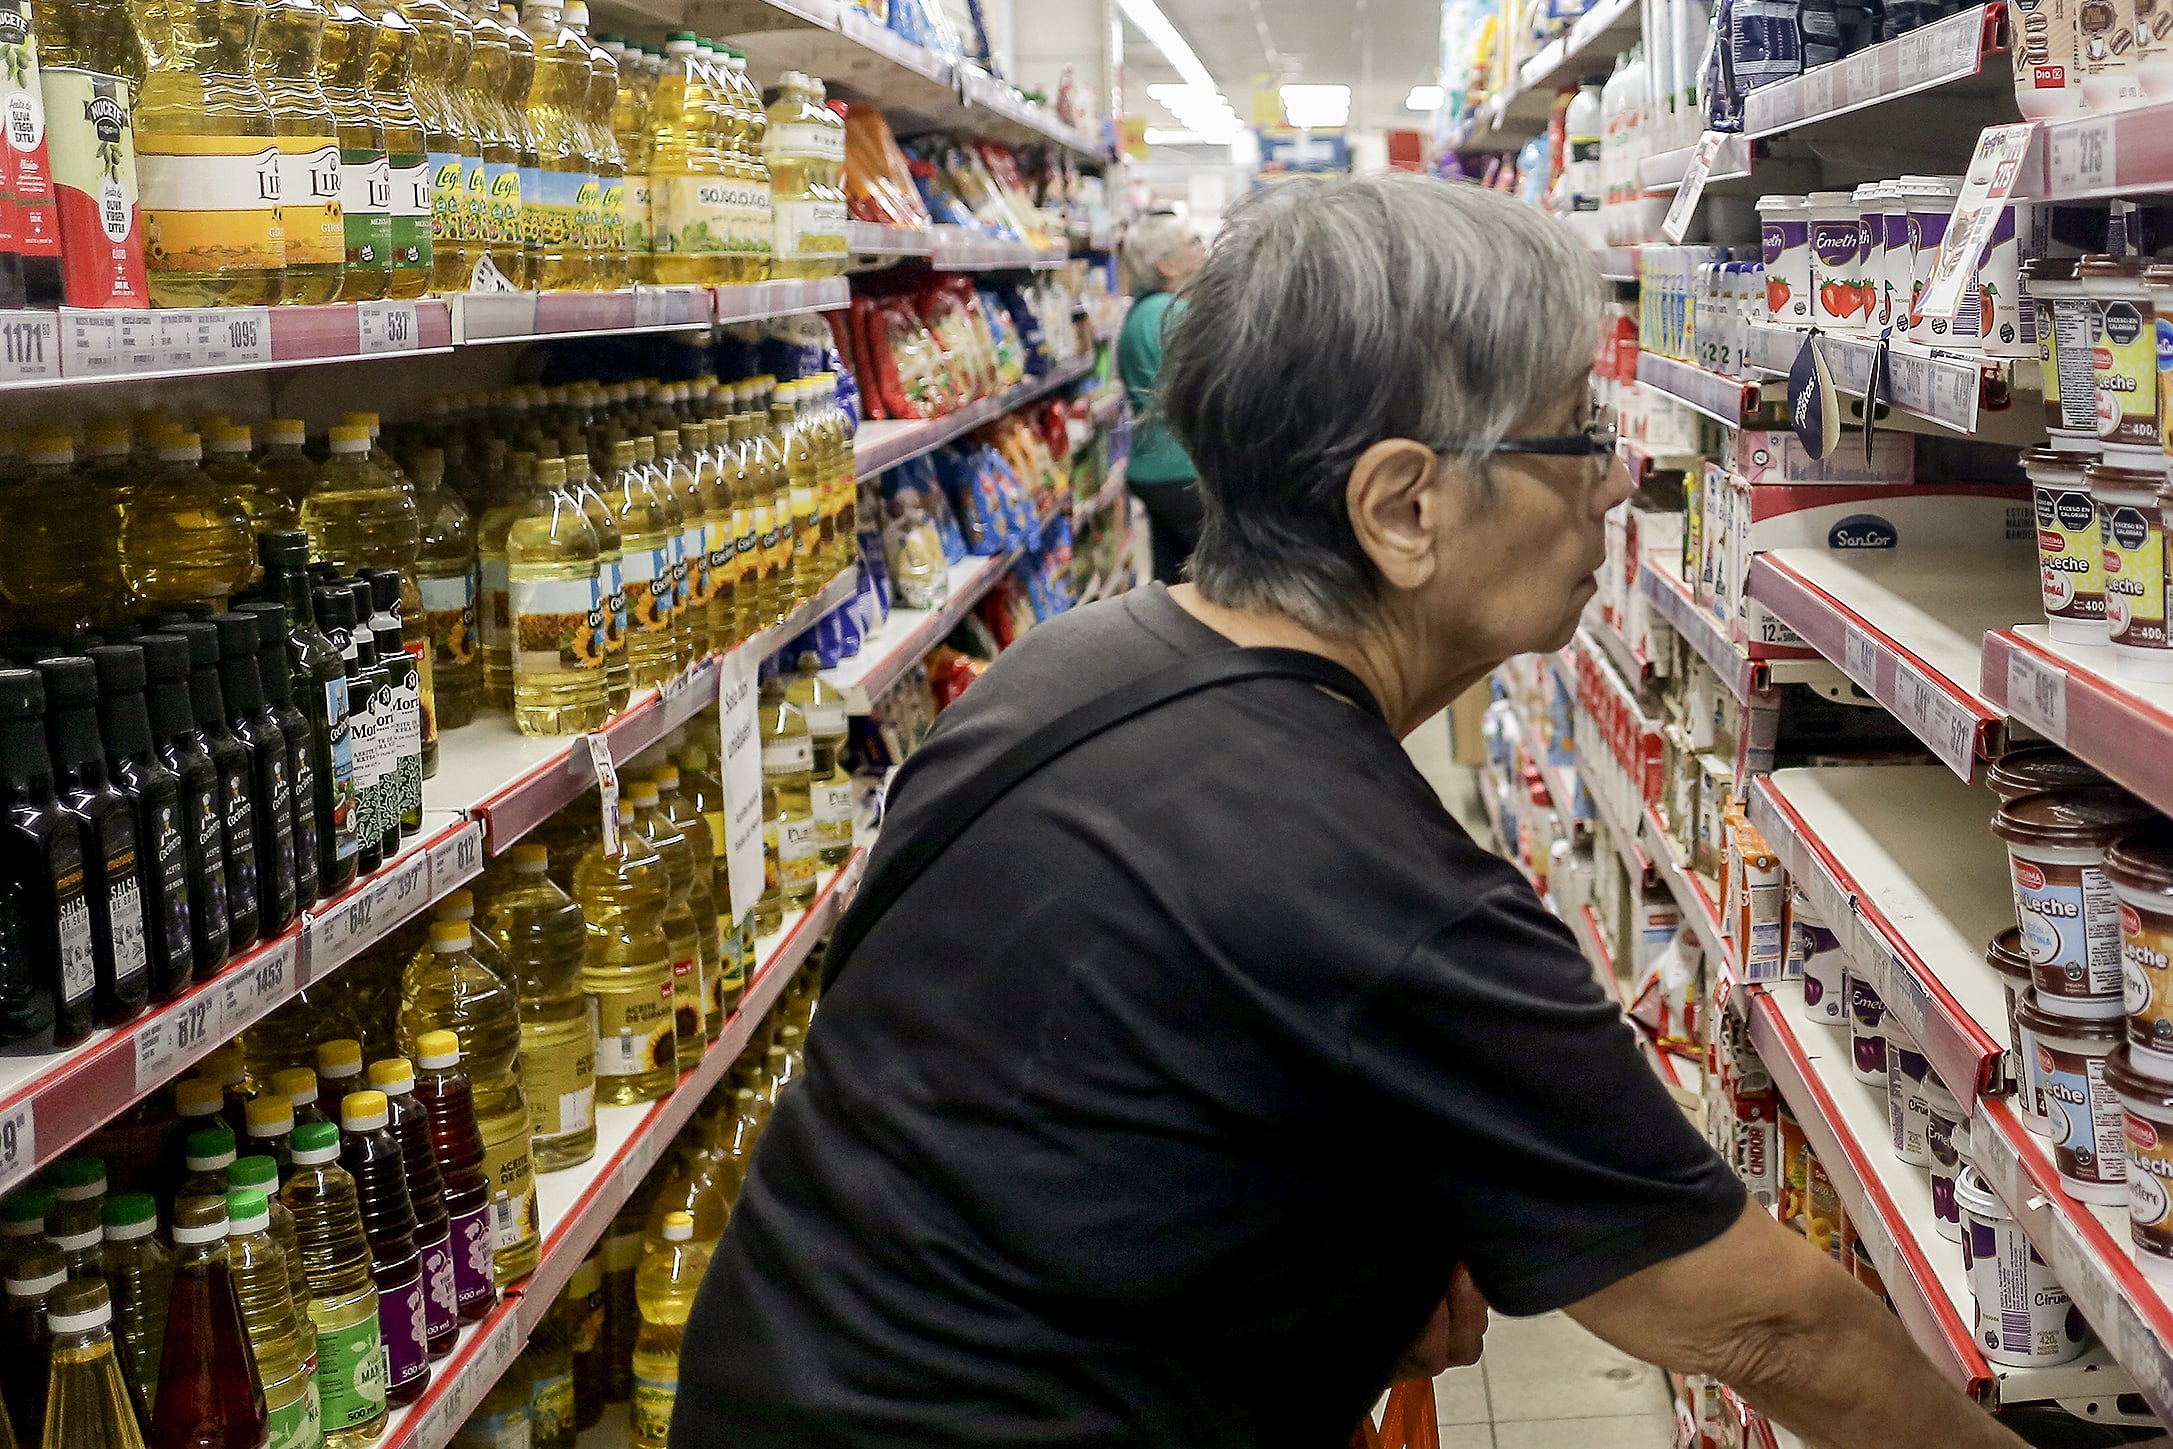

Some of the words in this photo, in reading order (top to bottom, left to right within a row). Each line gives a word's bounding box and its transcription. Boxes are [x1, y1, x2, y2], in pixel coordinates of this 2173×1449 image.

[90, 100, 125, 126] NUCETE
[1817, 231, 1858, 249] Emeth
[228, 321, 258, 348] 1095
[388, 312, 408, 342] 537
[3, 322, 44, 363] 1171
[1837, 530, 1891, 547] SanCor
[2049, 556, 2089, 572] Leche
[2085, 600, 2105, 612] 400
[1762, 624, 1776, 642] 12
[457, 836, 474, 870] 812
[110, 875, 138, 899] SALSA
[397, 870, 419, 900] 397
[60, 895, 87, 919] SALSA
[350, 897, 372, 934] 642
[2024, 892, 2078, 917] Leche
[255, 957, 283, 997] 1453
[177, 1001, 206, 1049] 872
[1750, 1127, 1765, 1176] CINDOR
[501, 1171, 514, 1184] DE
[458, 1292, 475, 1302] 500
[475, 1286, 486, 1298] ml
[439, 1320, 450, 1331] ml
[402, 1364, 418, 1378] 500
[347, 1408, 366, 1422] 500
[367, 1402, 377, 1415] ml
